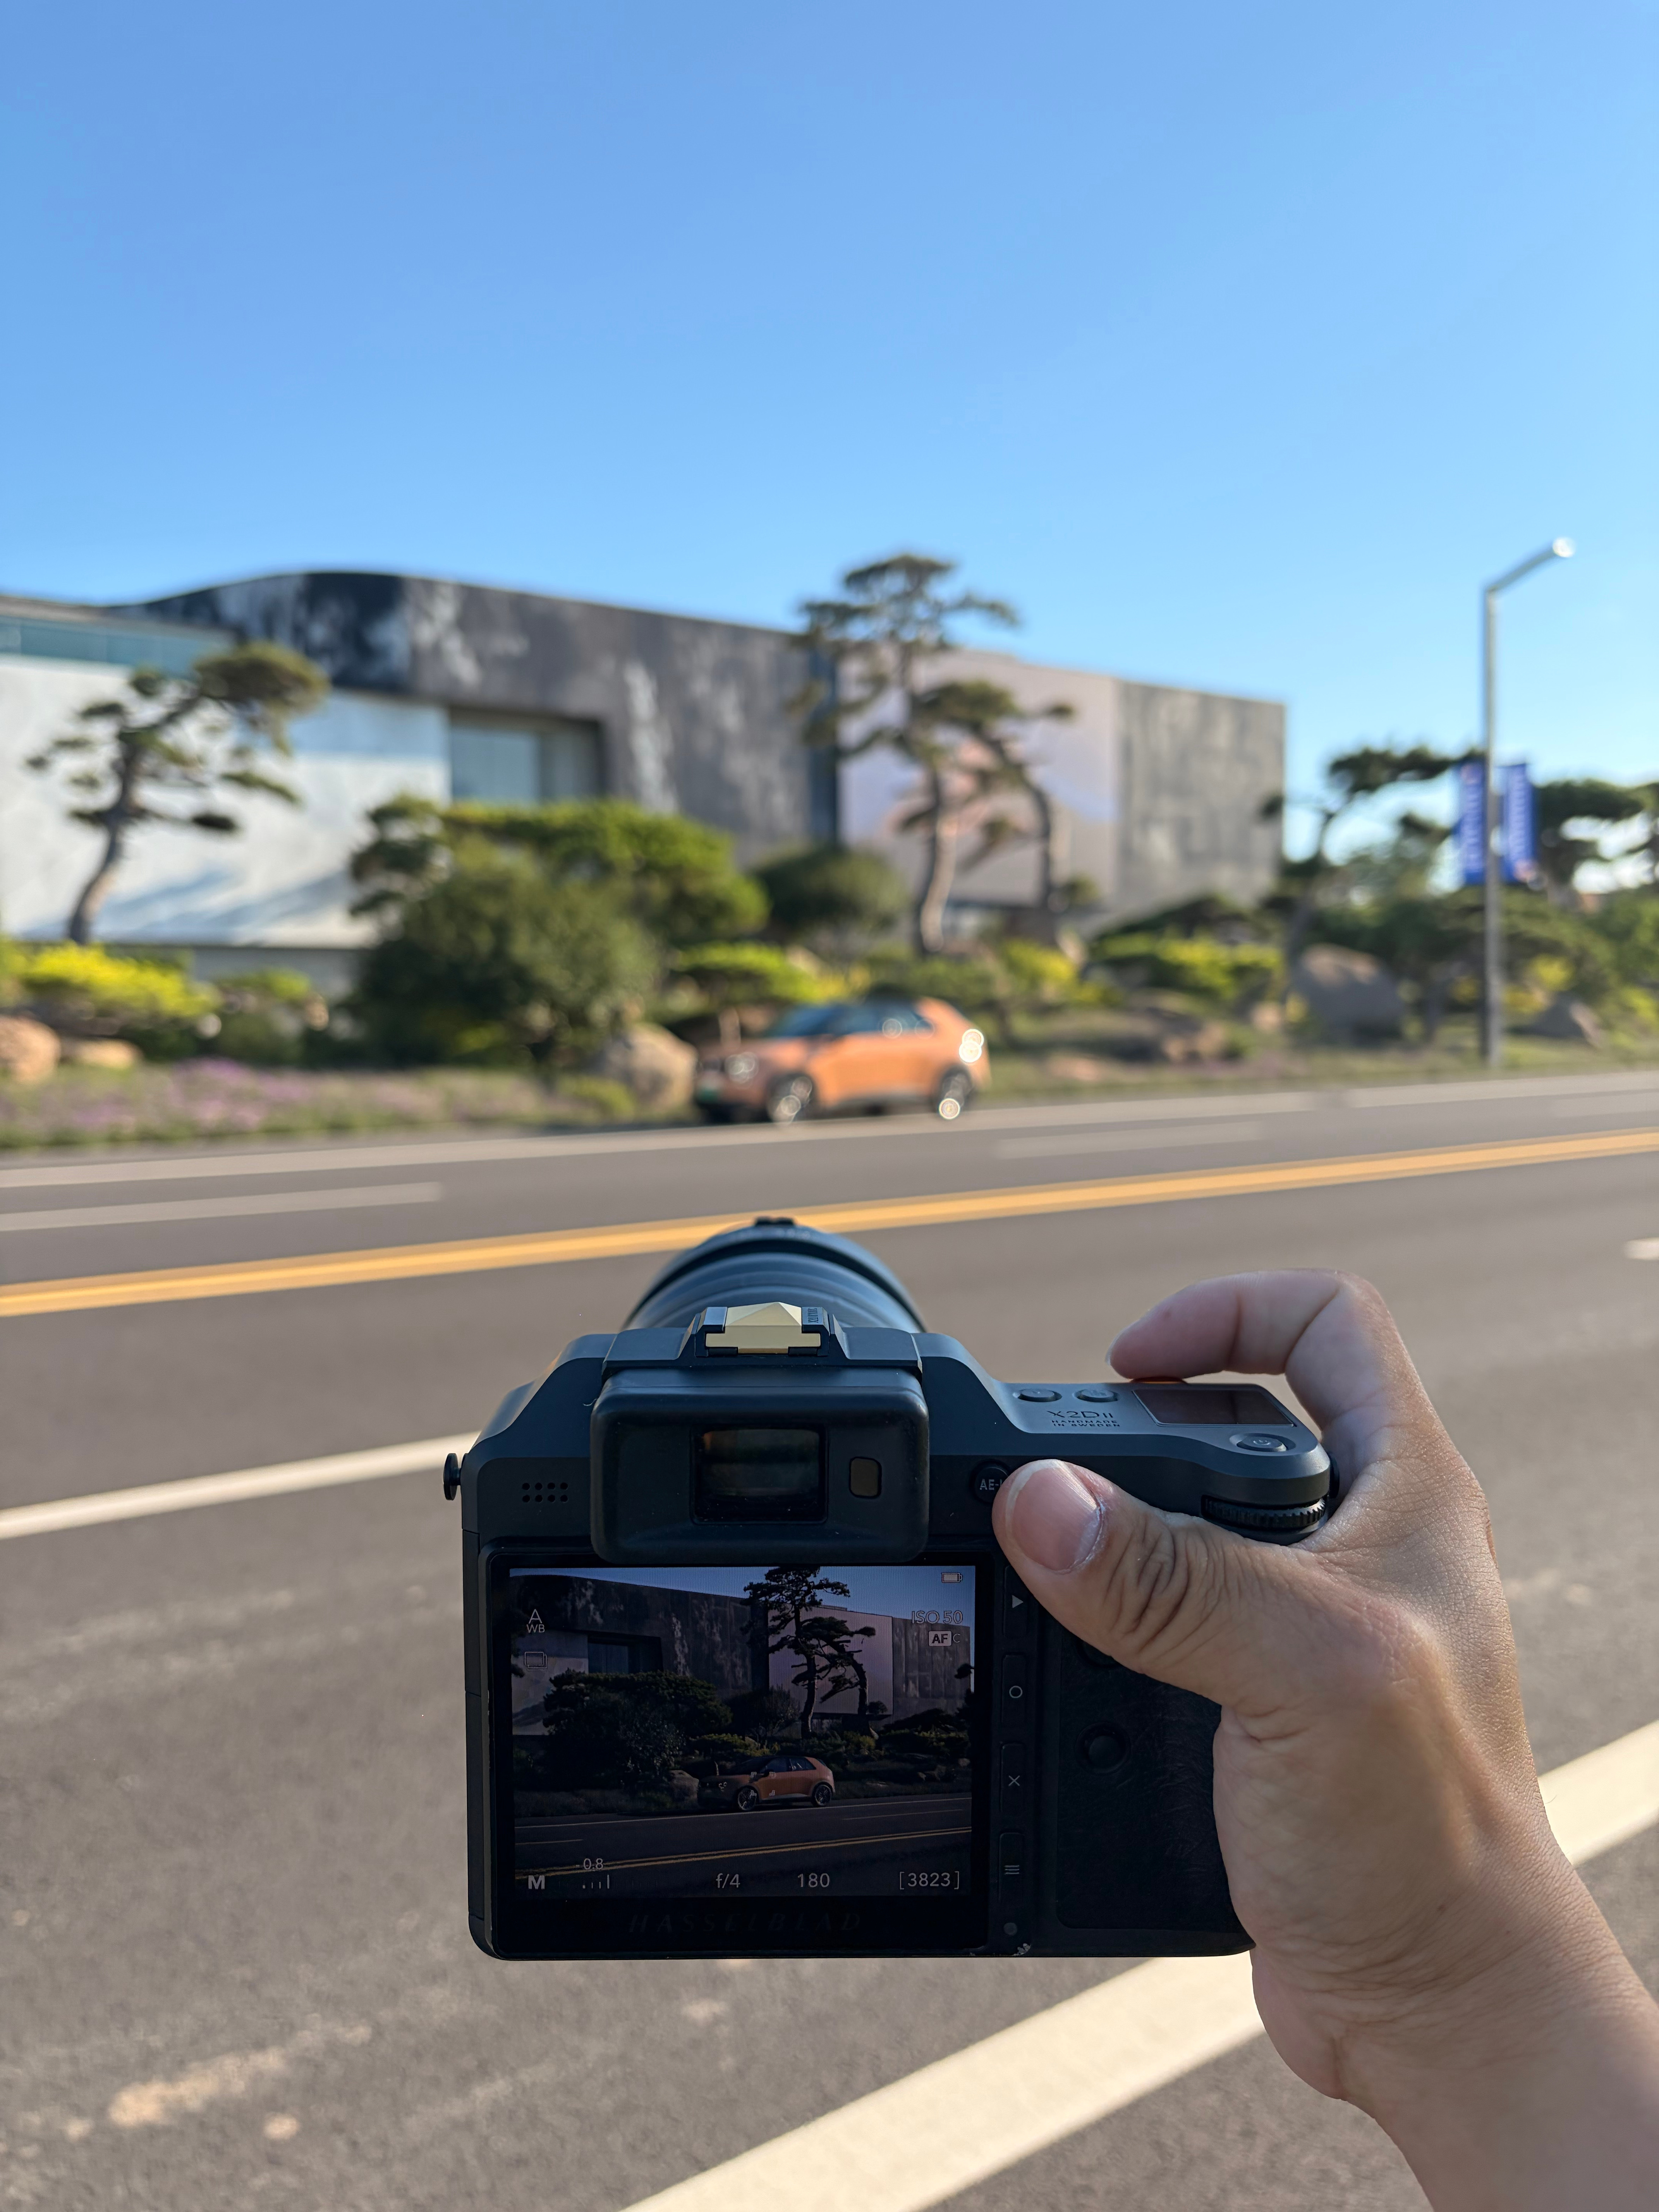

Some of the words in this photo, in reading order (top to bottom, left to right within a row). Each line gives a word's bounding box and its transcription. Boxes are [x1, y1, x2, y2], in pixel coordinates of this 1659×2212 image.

[912, 1610, 940, 1624] ISO
[943, 1610, 963, 1624] 50
[932, 1633, 948, 1644] AF
[953, 1633, 961, 1643] C
[528, 1875, 545, 1890] M
[716, 1873, 741, 1889] f/4
[797, 1873, 831, 1888] 180
[899, 1871, 960, 1890] [3823]
[628, 1912, 860, 1933] HASSELBLAD
